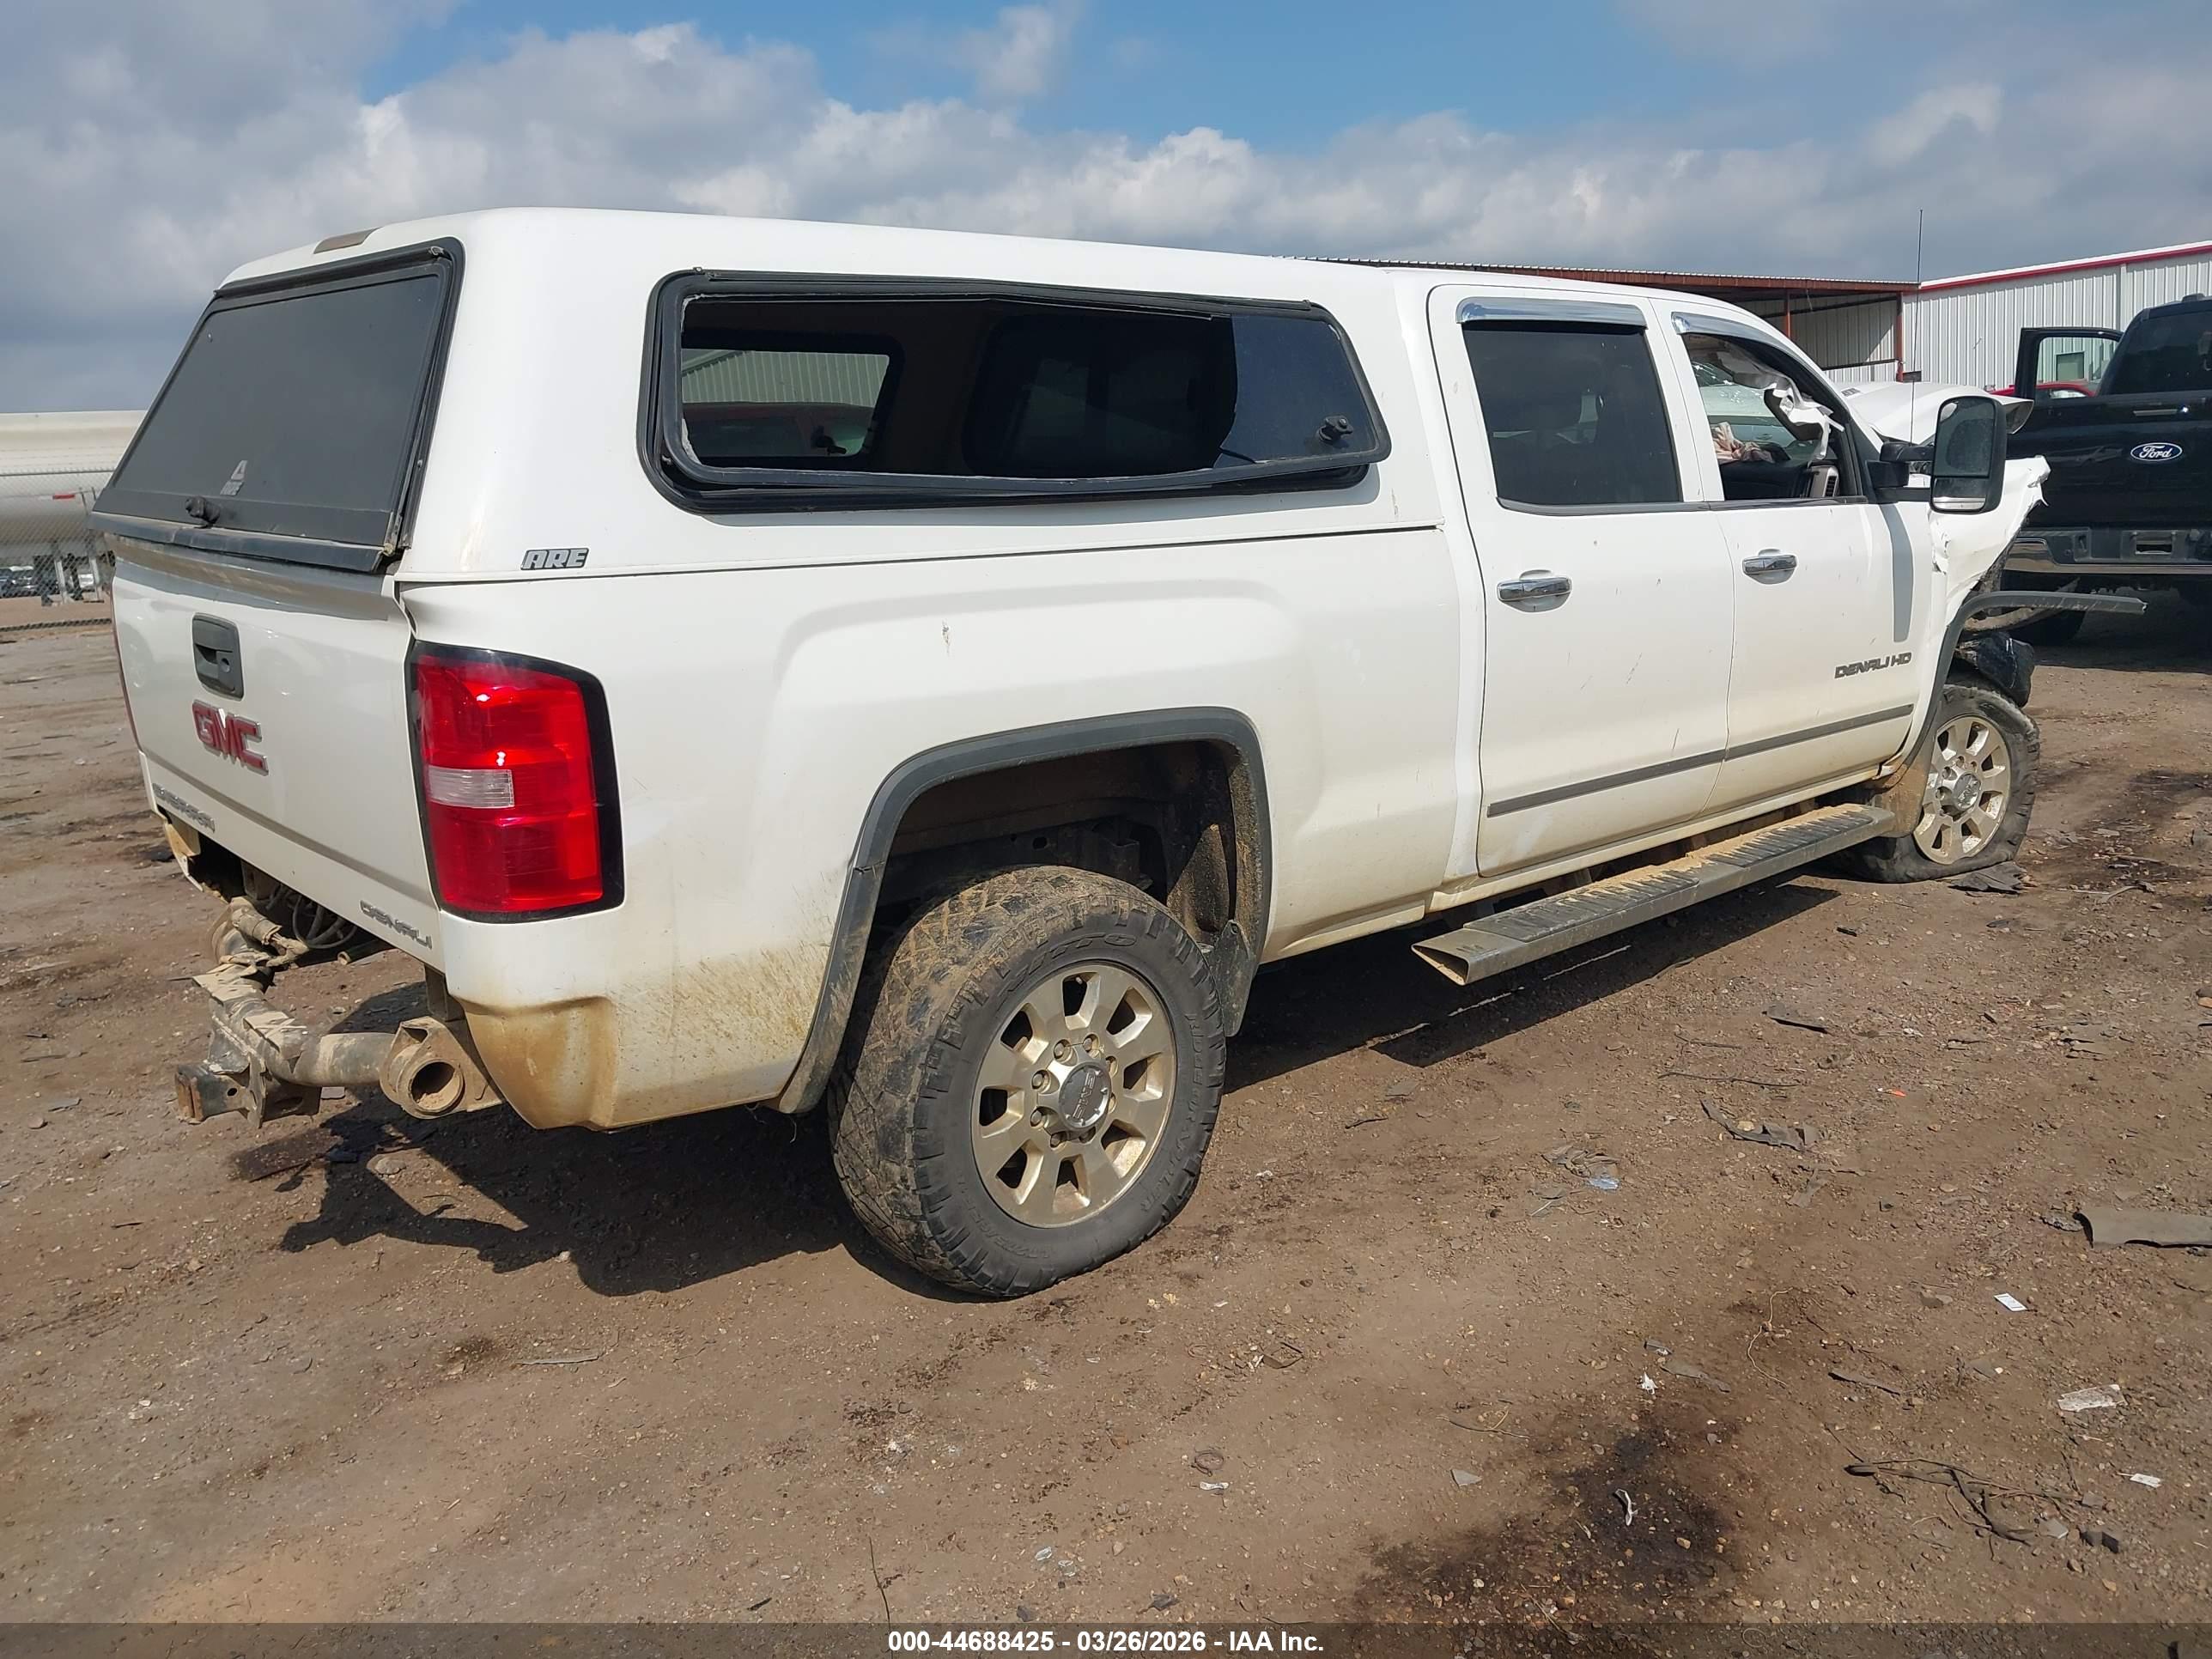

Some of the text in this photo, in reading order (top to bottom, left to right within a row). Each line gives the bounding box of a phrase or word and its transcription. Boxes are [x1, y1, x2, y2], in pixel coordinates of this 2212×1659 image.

[2139, 445, 2173, 459] Ford
[521, 548, 589, 570] ARE
[1834, 652, 1912, 678] DENALI HD
[192, 699, 269, 776] GMC
[360, 900, 432, 950] DENALI
[1072, 1071, 1096, 1119] GMC
